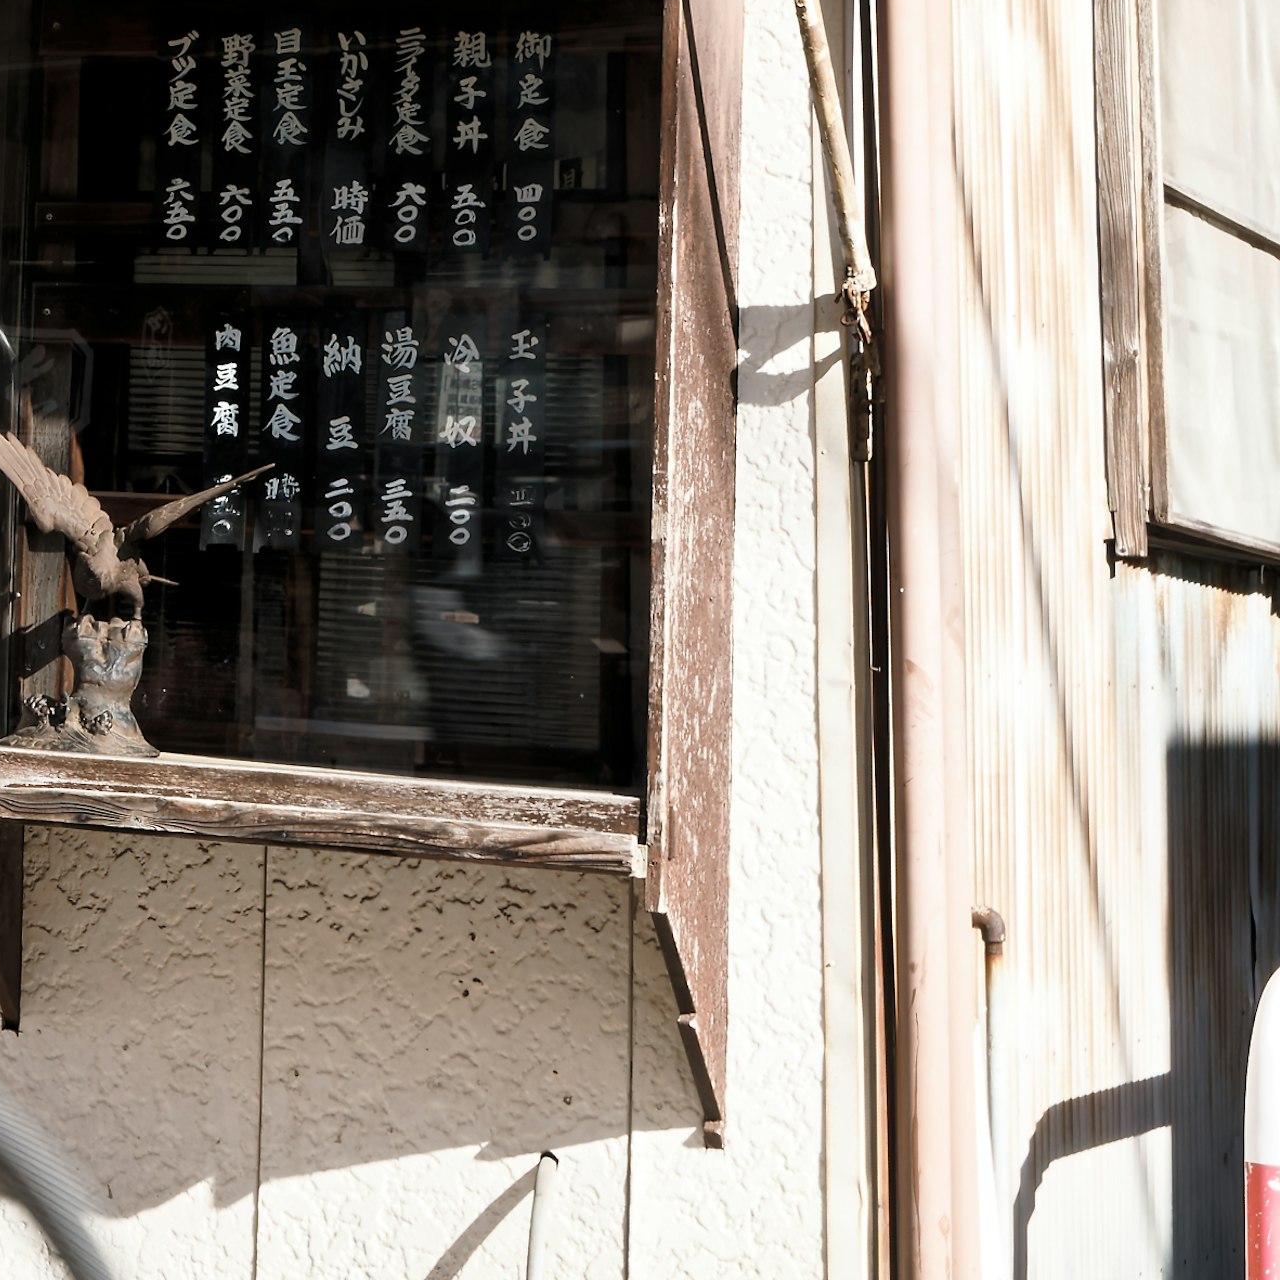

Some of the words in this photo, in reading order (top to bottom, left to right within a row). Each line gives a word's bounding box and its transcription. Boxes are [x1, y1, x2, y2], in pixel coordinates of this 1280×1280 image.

[163, 30, 199, 146] ブツ定食
[221, 33, 256, 154] 野菜定食
[272, 28, 308, 145] 目玉定食
[337, 31, 368, 141] いかさしみ
[453, 31, 491, 154] 親子丼
[514, 31, 552, 152] 御定食
[329, 179, 369, 245] 時価
[210, 322, 242, 438] 肉豆腐
[262, 326, 302, 441] 魚定食
[323, 333, 362, 450] 納豆
[380, 326, 420, 441] 湯豆腐
[438, 333, 482, 449] 冷奴
[506, 328, 540, 455] 玉子丼
